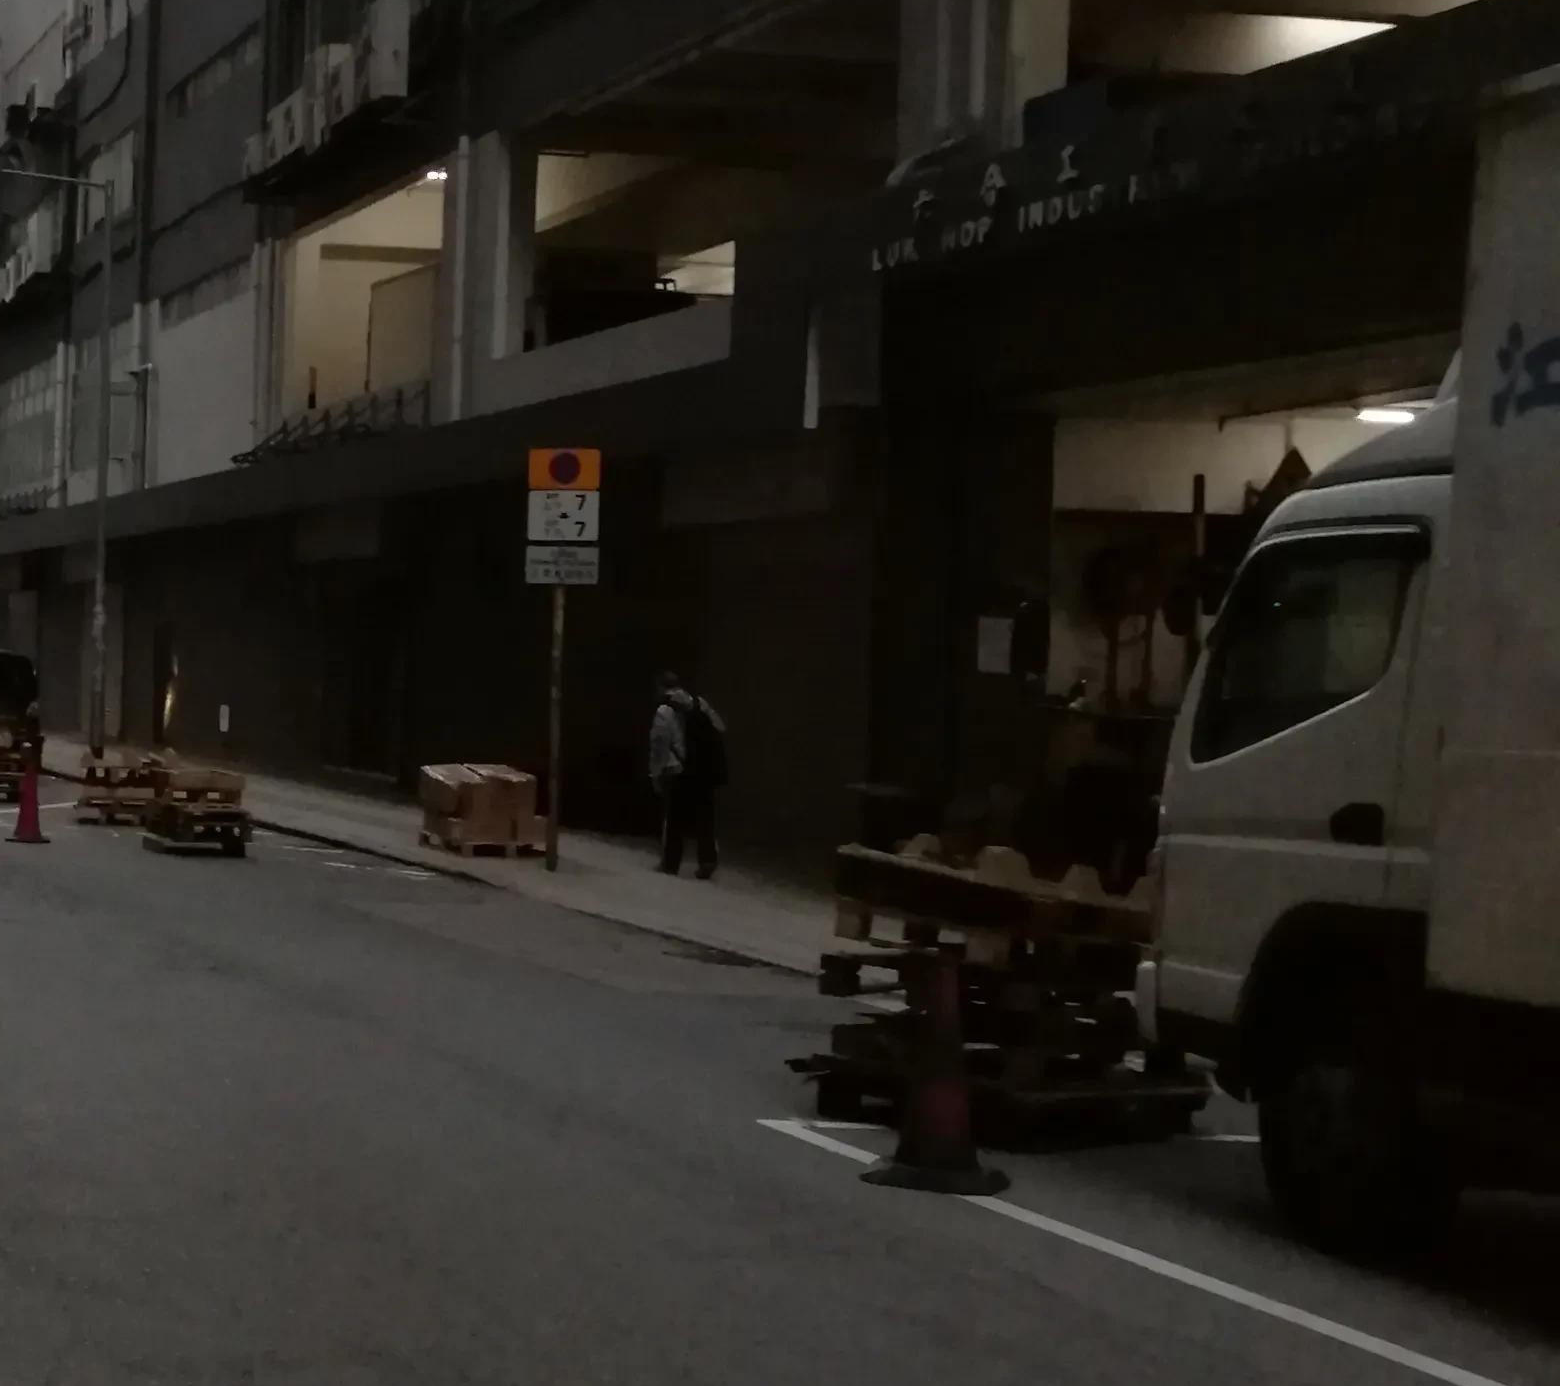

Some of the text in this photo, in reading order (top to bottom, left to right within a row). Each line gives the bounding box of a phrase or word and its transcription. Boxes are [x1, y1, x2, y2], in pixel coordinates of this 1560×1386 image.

[871, 237, 918, 272] LUK
[940, 215, 993, 253] HOP
[574, 493, 587, 511] 7
[574, 520, 587, 538] 7
